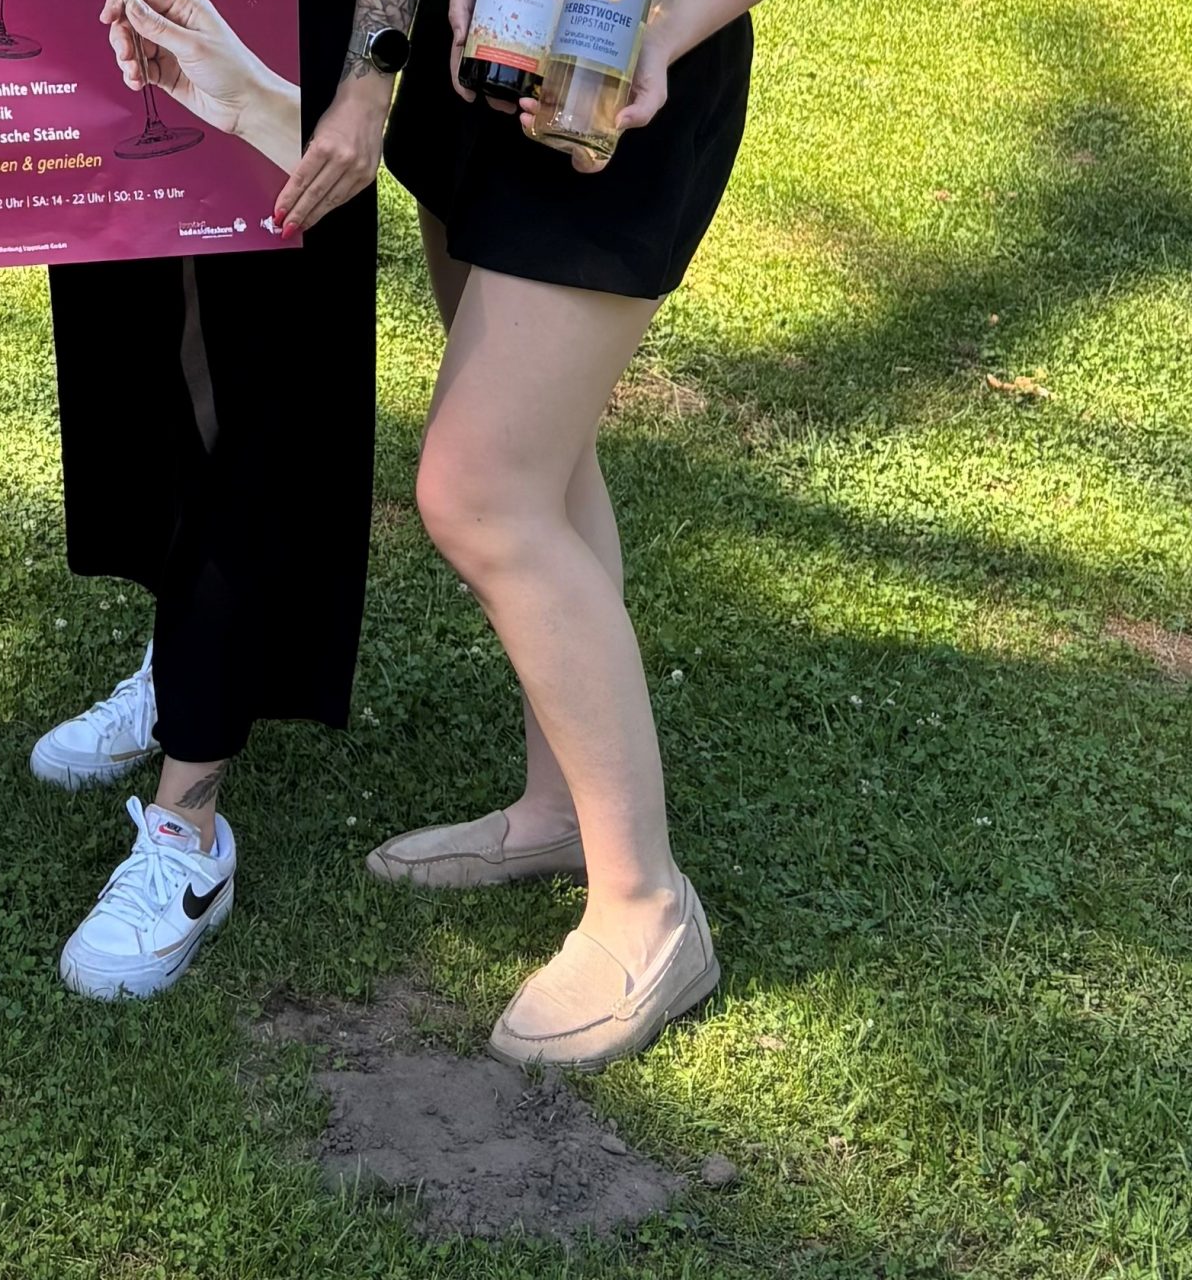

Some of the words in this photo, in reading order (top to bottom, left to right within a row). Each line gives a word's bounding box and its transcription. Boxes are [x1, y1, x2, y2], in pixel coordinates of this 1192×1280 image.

[570, 15, 616, 34] LIPPSTADT
[30, 81, 78, 95] Winzer
[33, 126, 80, 141] Stände
[22, 155, 33, 171] &
[37, 152, 102, 174] genießen
[5, 197, 24, 209] Uhr
[32, 195, 49, 207] SA:
[51, 195, 63, 206] 14
[72, 193, 85, 205] 22
[87, 192, 105, 204] Uhr
[113, 190, 131, 202] SO:
[133, 190, 144, 201] 12
[153, 188, 165, 199] 19
[166, 188, 185, 199] Uhr
